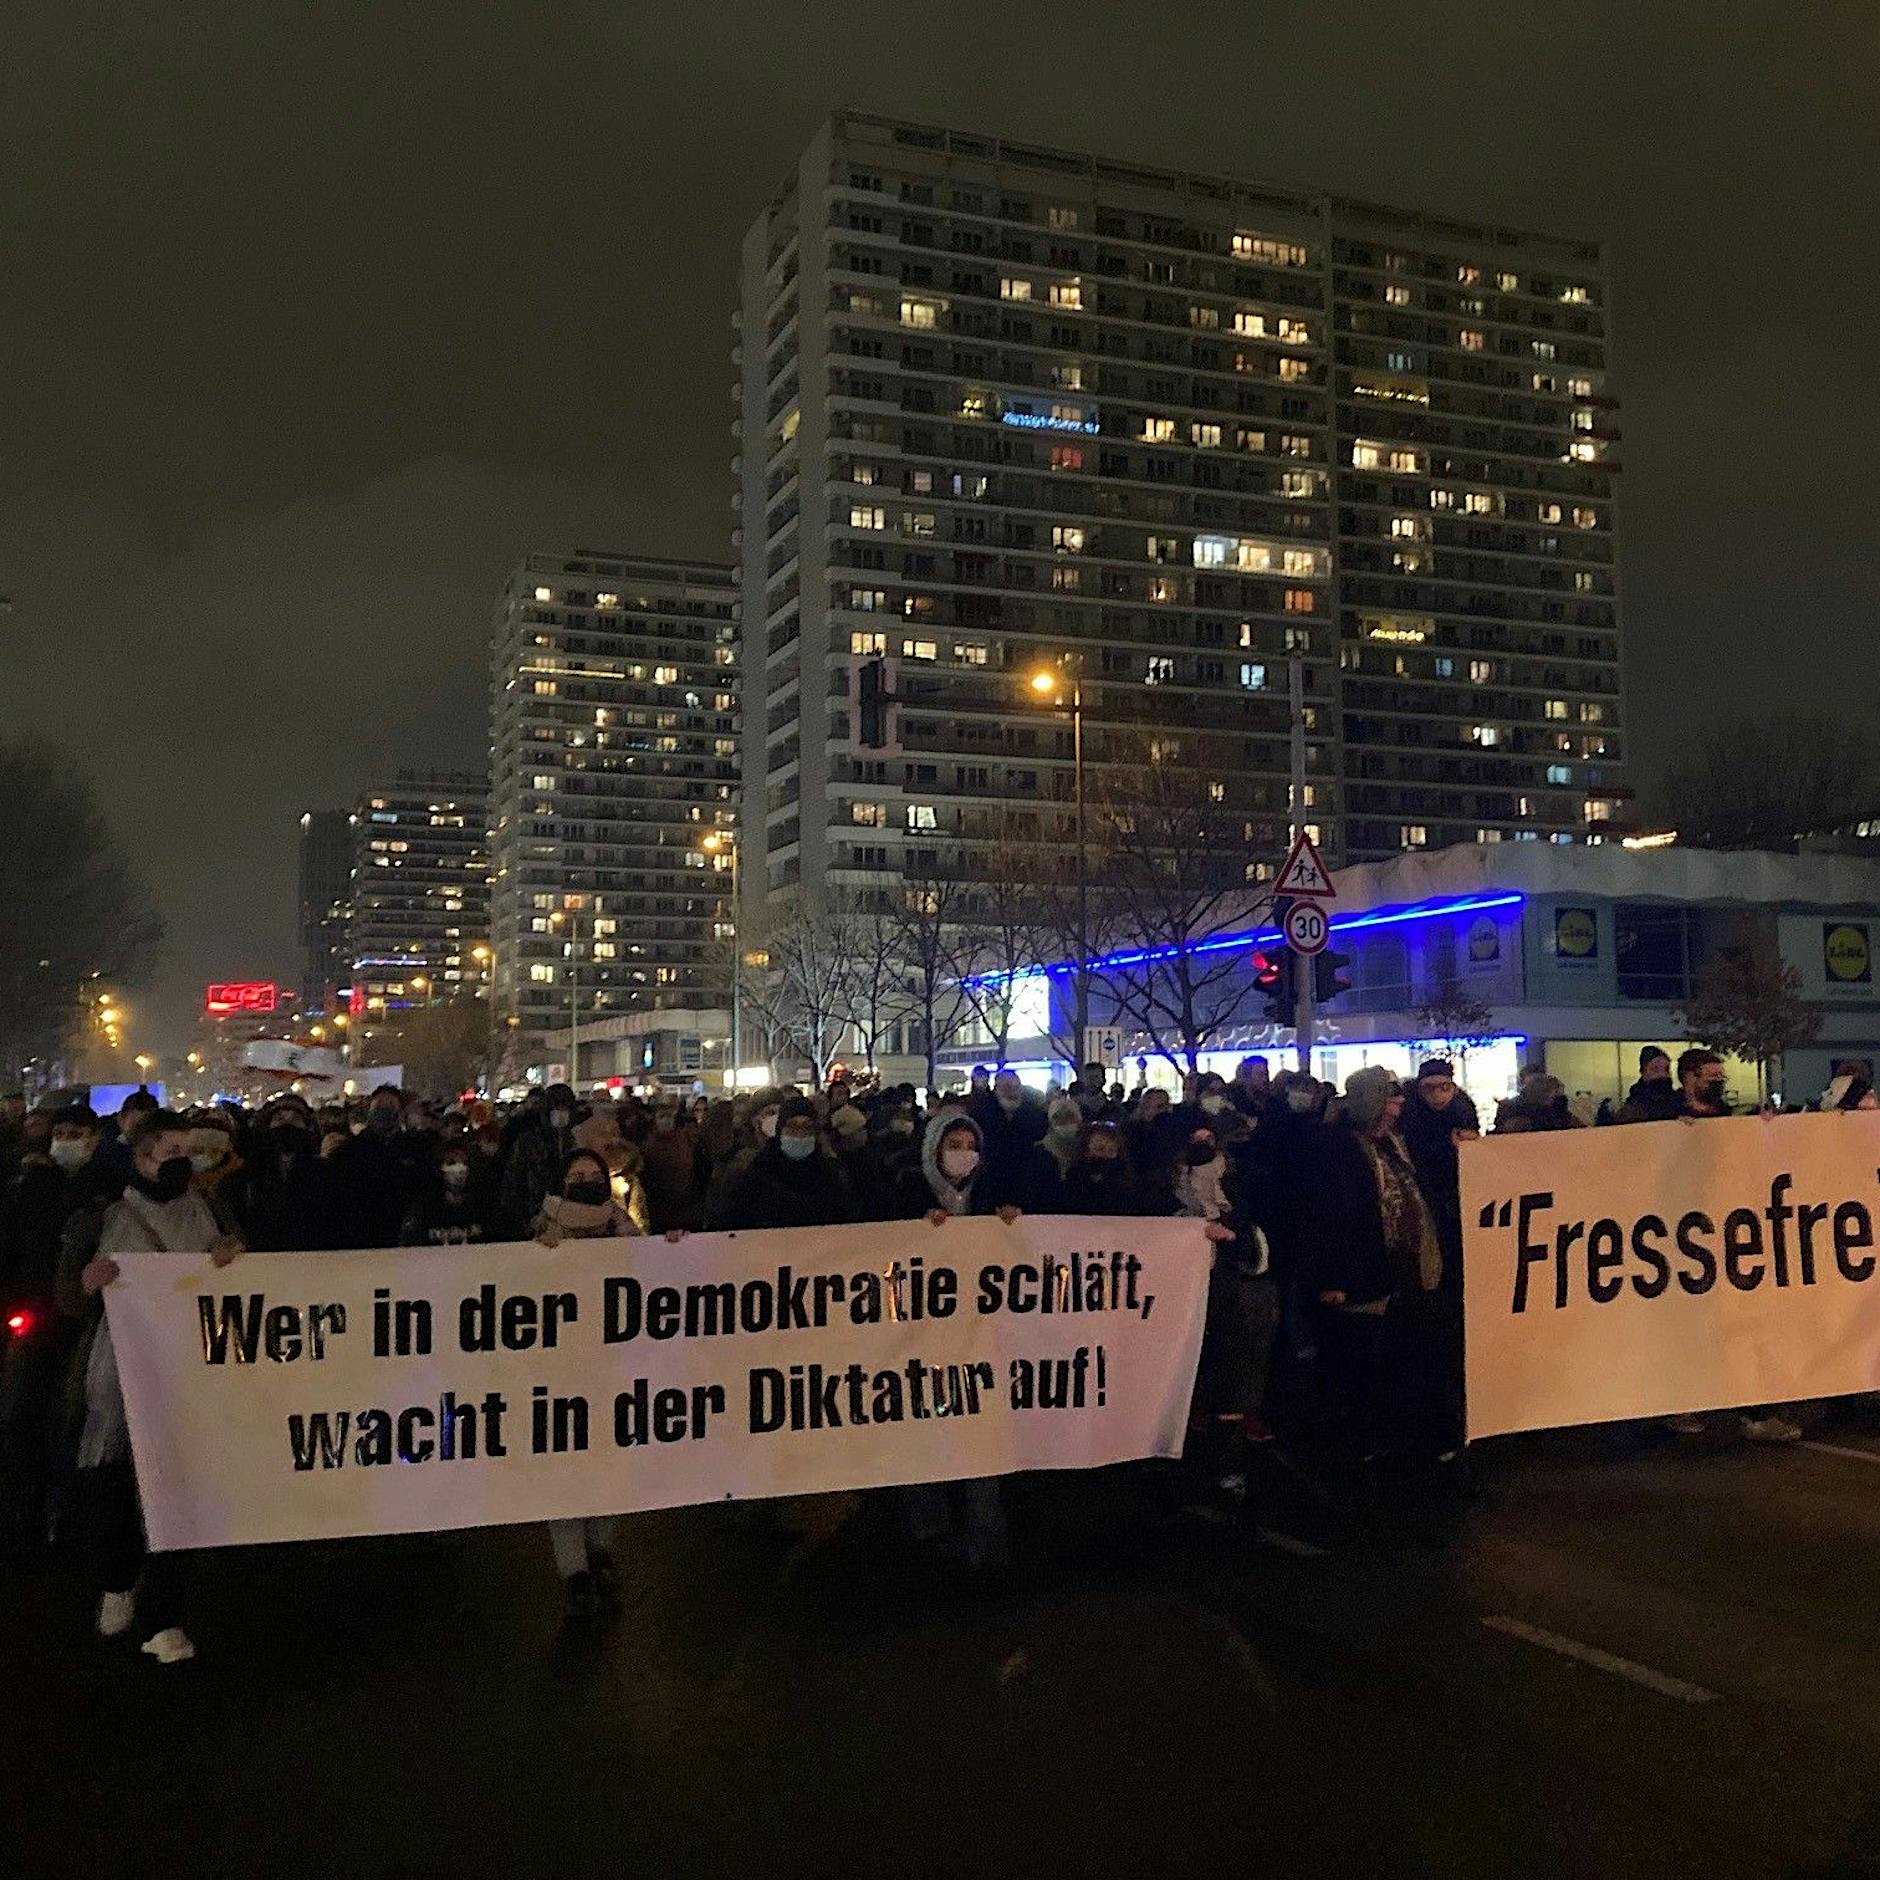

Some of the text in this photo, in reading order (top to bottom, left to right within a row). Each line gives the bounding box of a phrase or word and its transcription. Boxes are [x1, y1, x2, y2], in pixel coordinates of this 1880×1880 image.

[1295, 916, 1321, 939] 30
[1479, 1168, 1880, 1315] “Fressefre
[196, 1250, 1156, 1366] Wer in der Demokratie schläft,
[288, 1344, 1107, 1473] wacht in der Diktatur auf!
